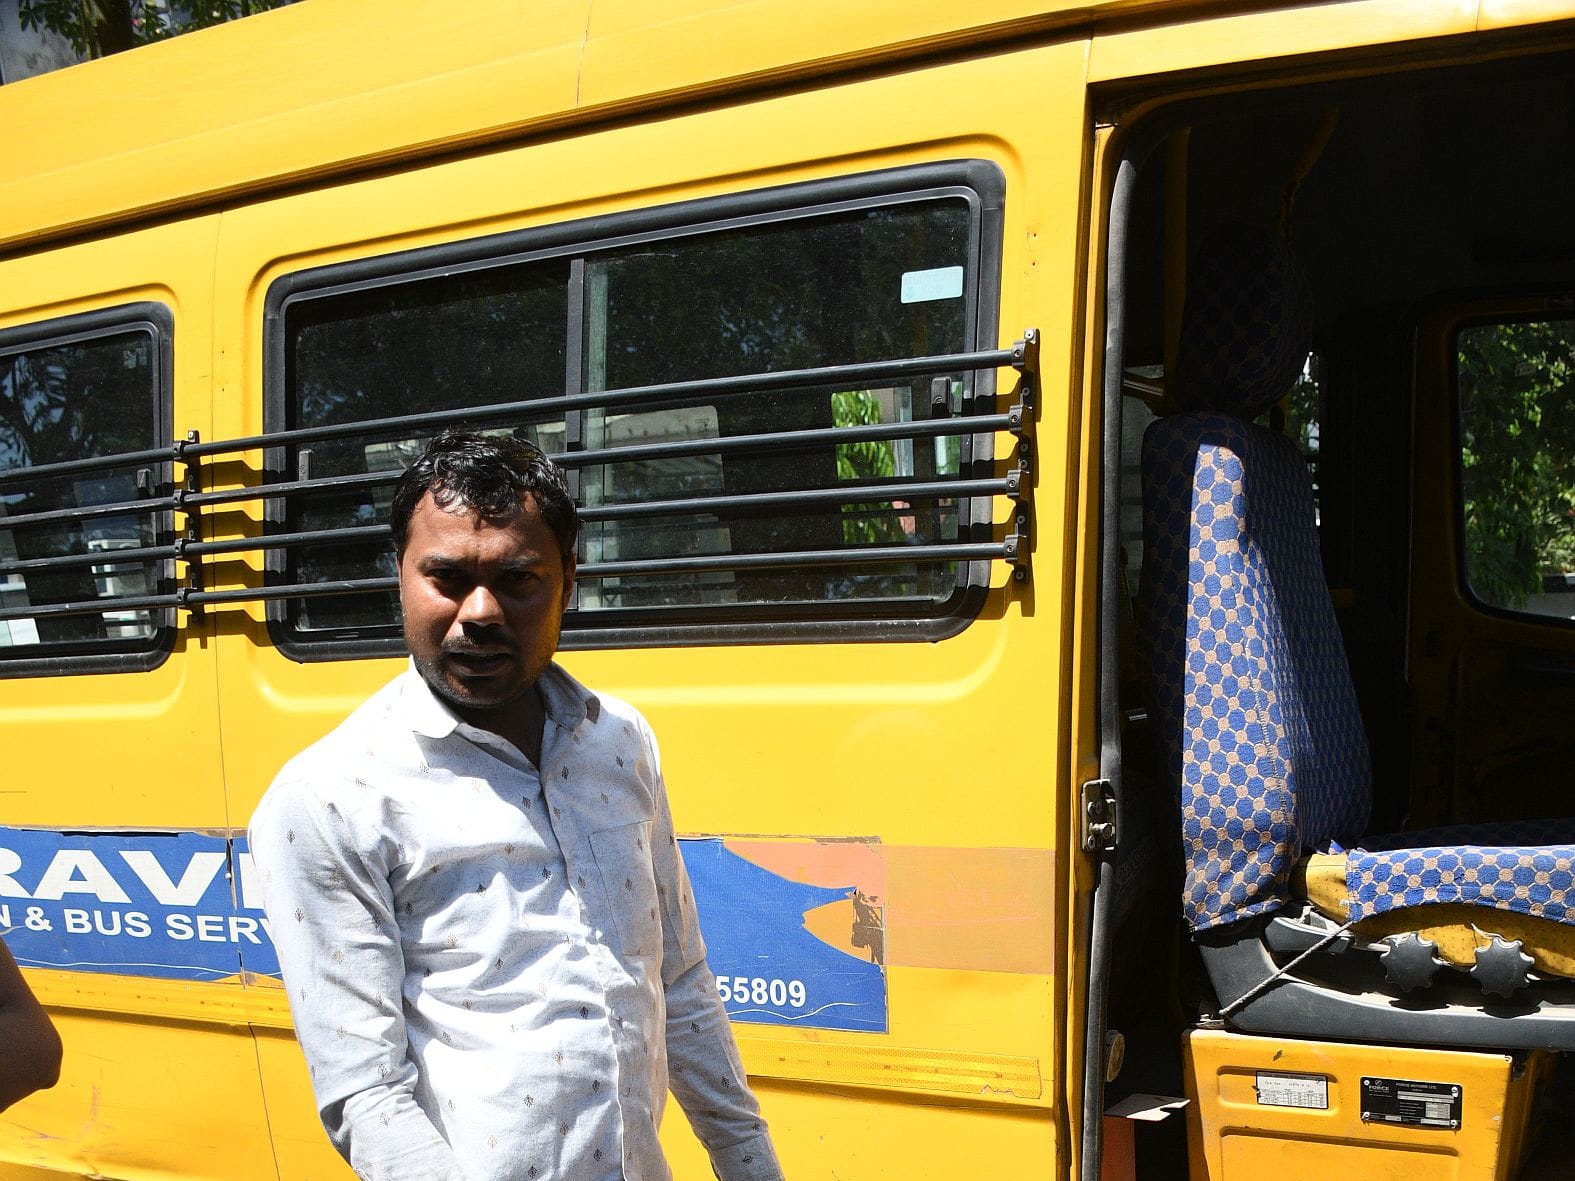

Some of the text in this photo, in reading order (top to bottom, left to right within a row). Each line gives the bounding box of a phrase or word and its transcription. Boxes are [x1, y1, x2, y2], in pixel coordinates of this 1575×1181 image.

[0, 847, 265, 910] AV
[24, 906, 54, 932] &
[63, 908, 152, 938] BUS
[715, 975, 806, 1008] 55809
